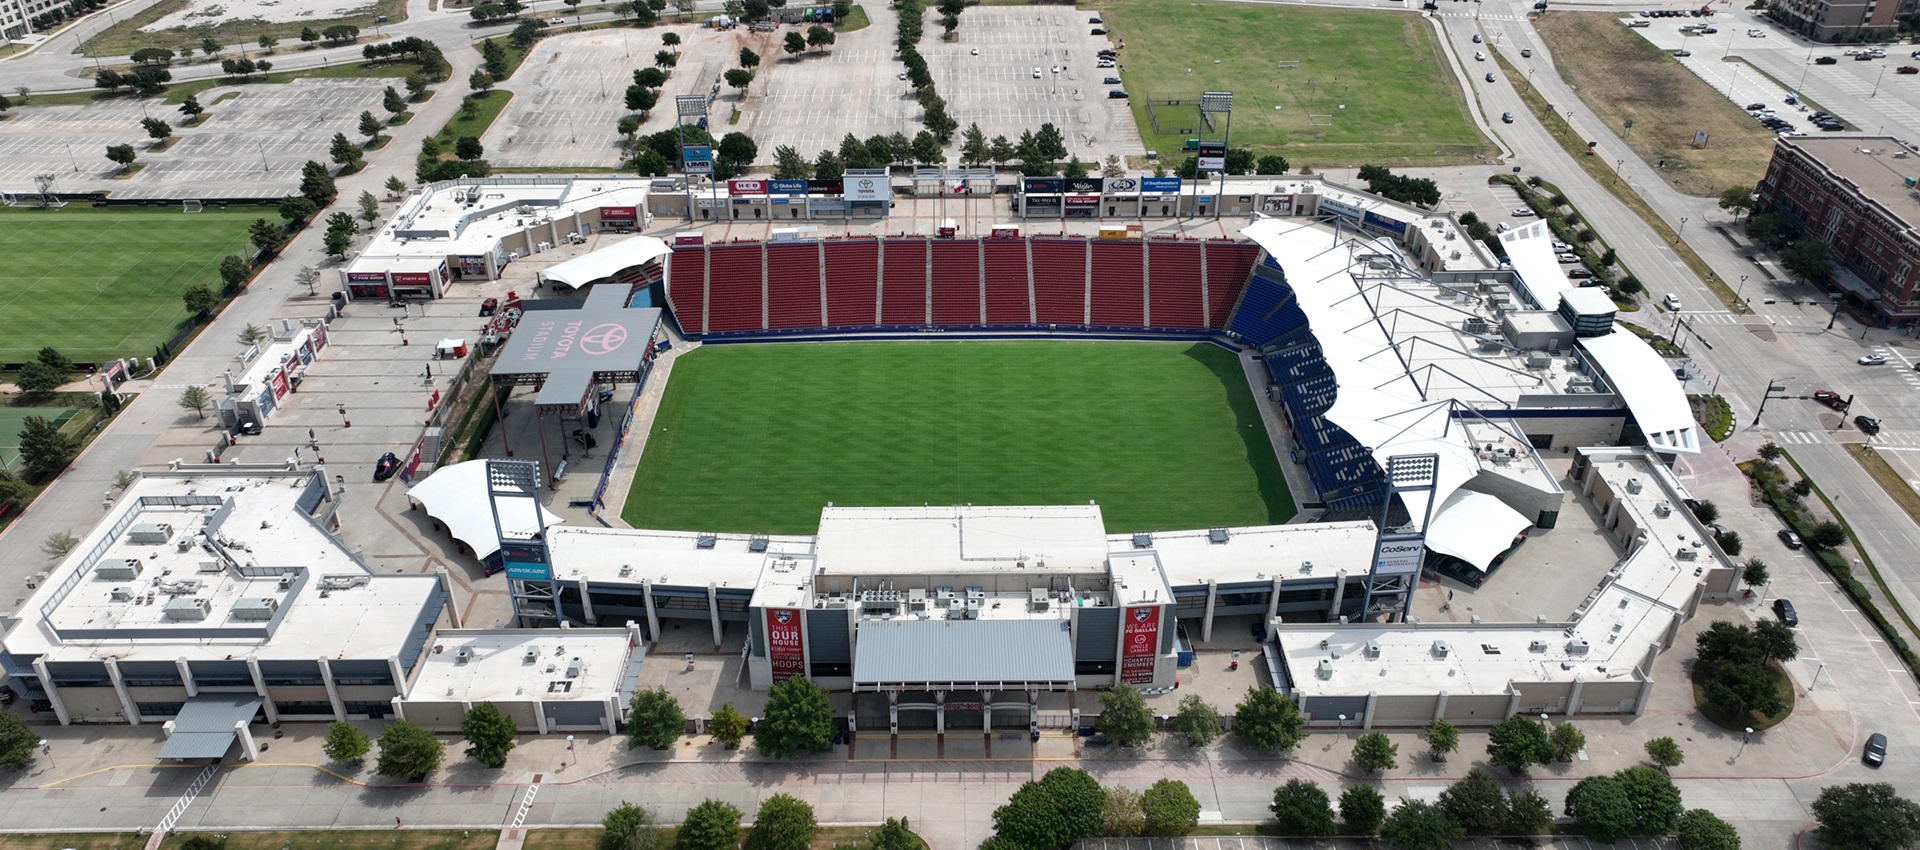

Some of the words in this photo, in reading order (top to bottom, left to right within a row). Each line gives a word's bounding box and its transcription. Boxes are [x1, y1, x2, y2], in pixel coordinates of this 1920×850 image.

[523, 320, 556, 360] STADIUM
[550, 320, 583, 359] TOYOTA
[772, 631, 799, 640] OUR
[773, 660, 804, 669] HOOPS
